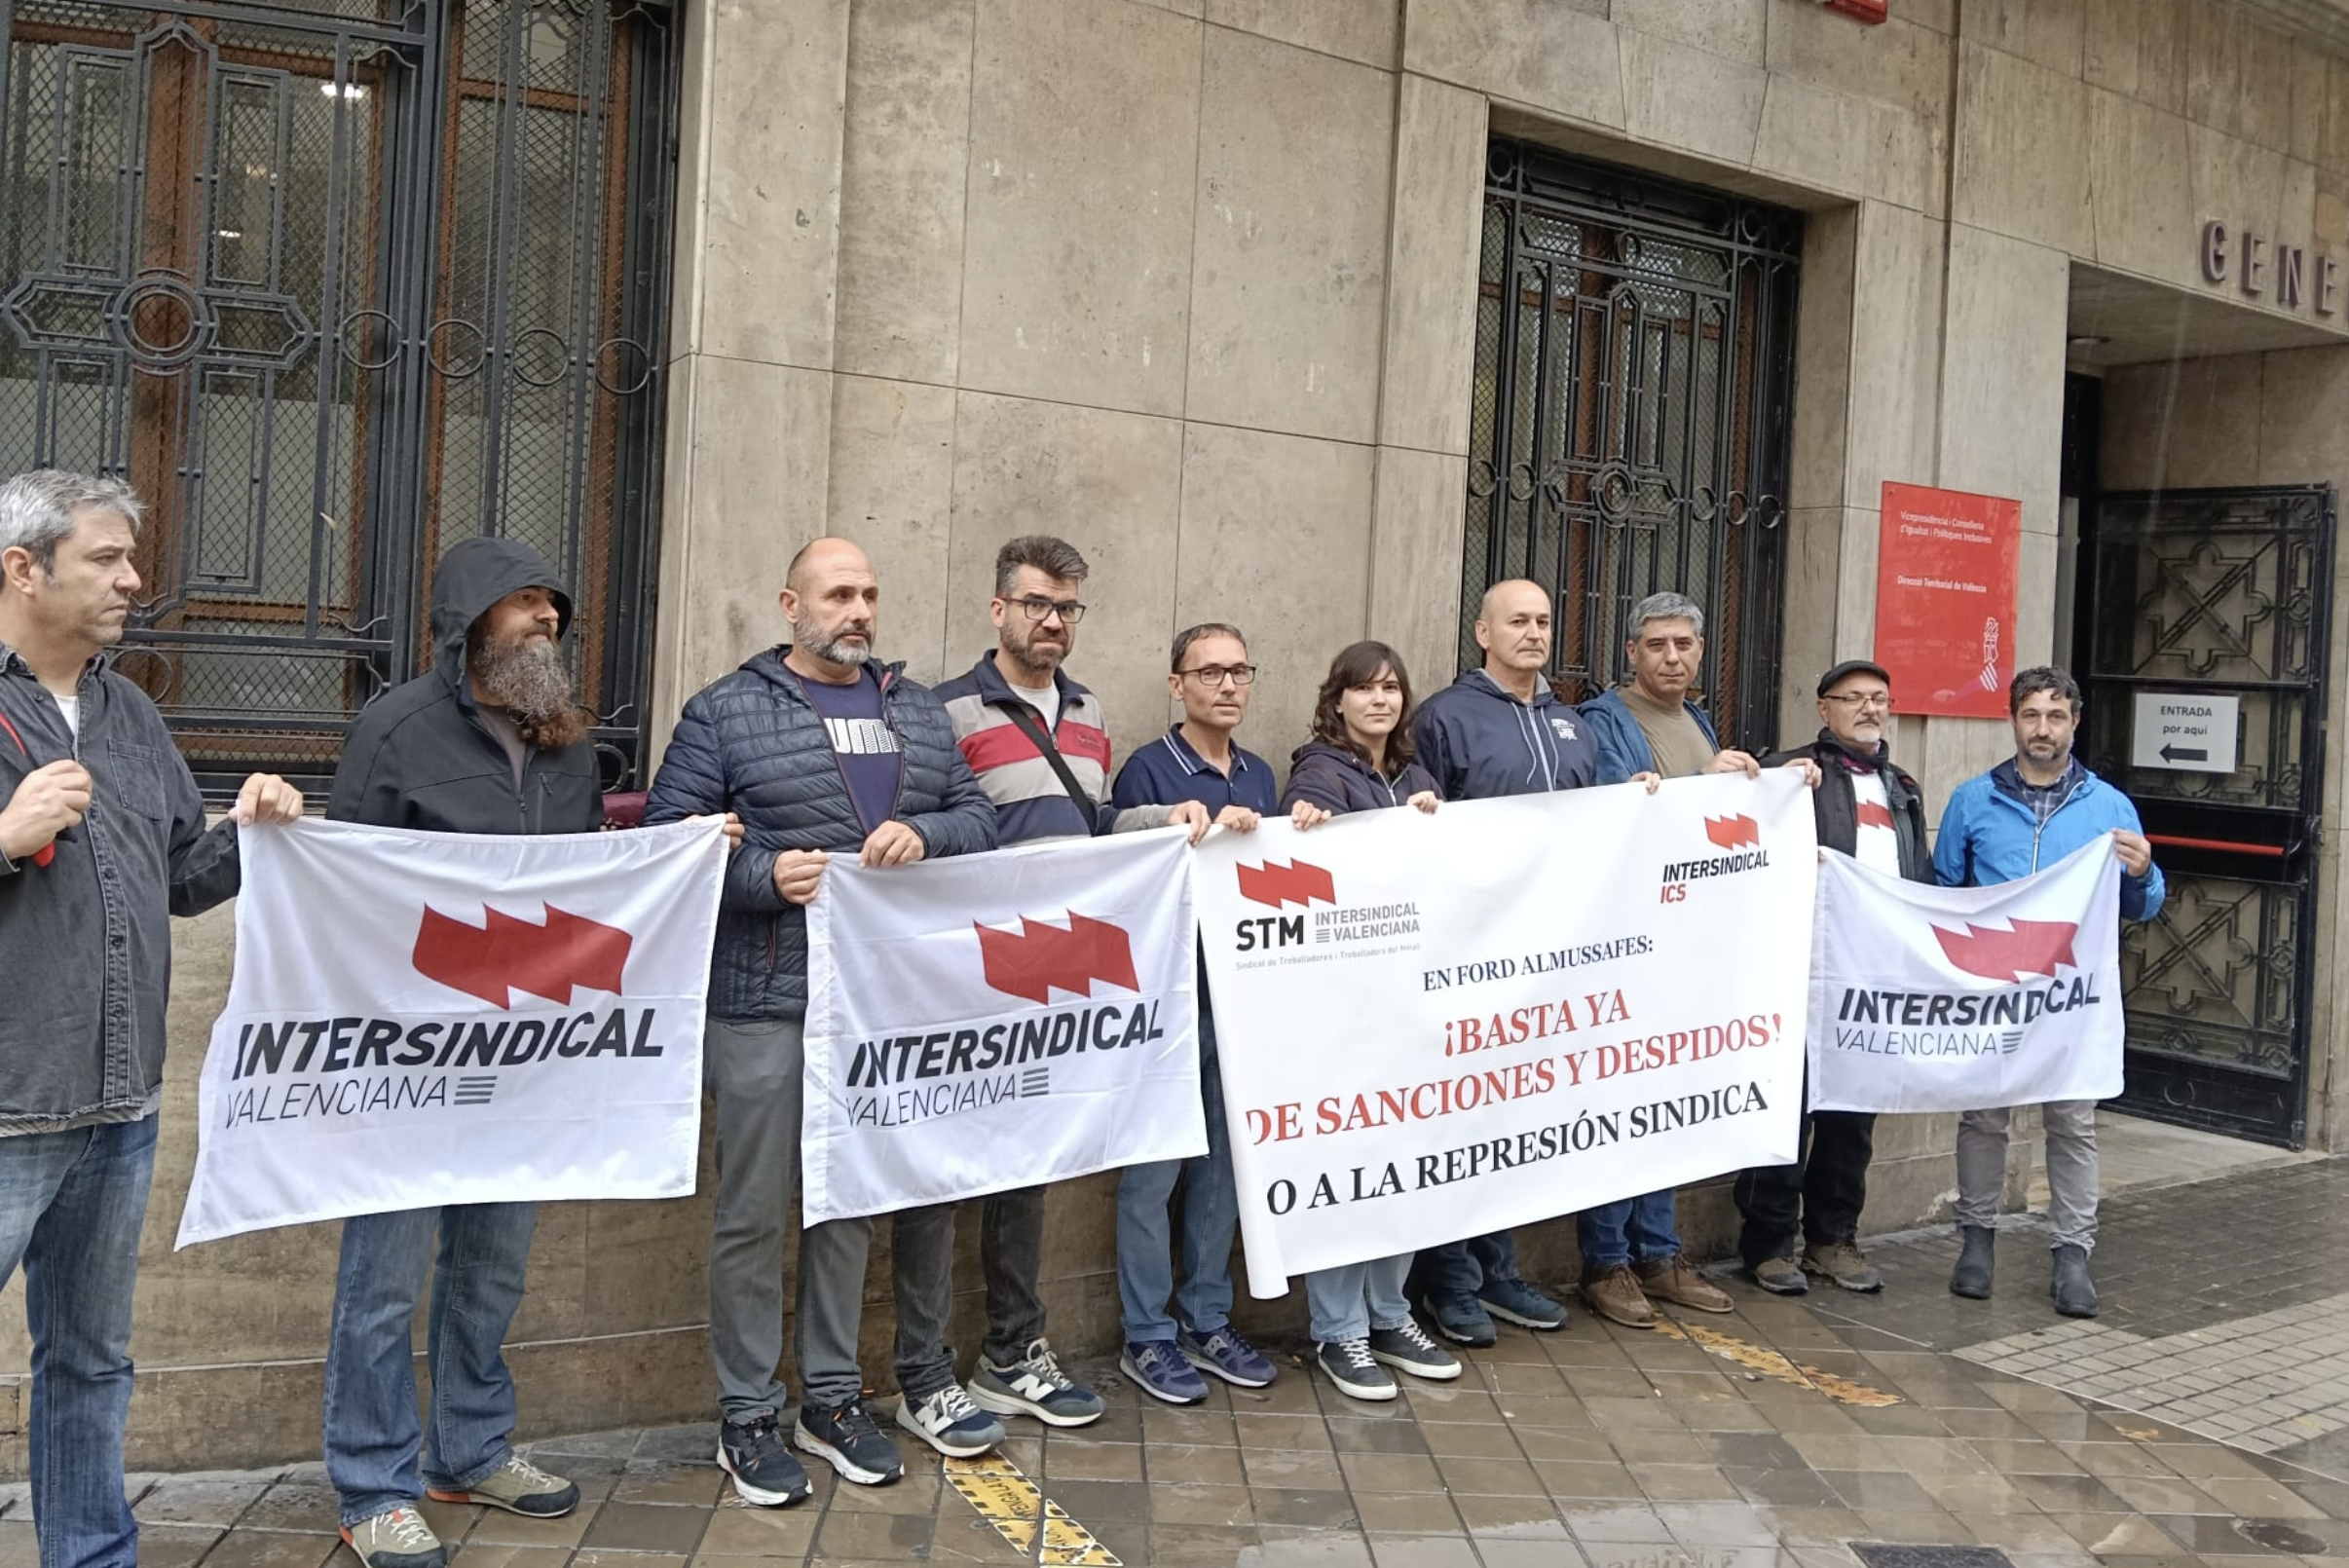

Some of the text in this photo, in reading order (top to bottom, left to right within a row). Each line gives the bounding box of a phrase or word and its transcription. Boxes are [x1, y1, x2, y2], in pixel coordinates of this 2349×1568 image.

[2202, 220, 2349, 323] GENE
[2160, 706, 2213, 717] ENTRADA
[2163, 725, 2209, 735] por aquí
[1663, 849, 1770, 882] INTERSINDICAL
[1316, 902, 1420, 926] INTERSINDICAL
[1660, 883, 1686, 904] ICS
[1236, 915, 1304, 952] STM
[1333, 919, 1420, 941] VALENCIANA
[1236, 958, 1266, 971] Sindicat
[1267, 958, 1276, 967] de
[1423, 935, 1654, 991] EN FORD ALMUSSAFES:
[232, 1008, 664, 1081] INTERSINDICAL
[846, 999, 1164, 1088] INTERSINDICAL
[1444, 988, 1631, 1058] ¡BASTA YA
[1836, 1027, 1997, 1056] VALENCIANA
[225, 1074, 447, 1130] VALENCIANA
[845, 1073, 1016, 1128] VALENCIANA
[1246, 1013, 1781, 1145] DE SANCIONES Y DESPIDOS!
[1267, 1079, 1771, 1215] O A LA REPRESIÓN SINDICA
